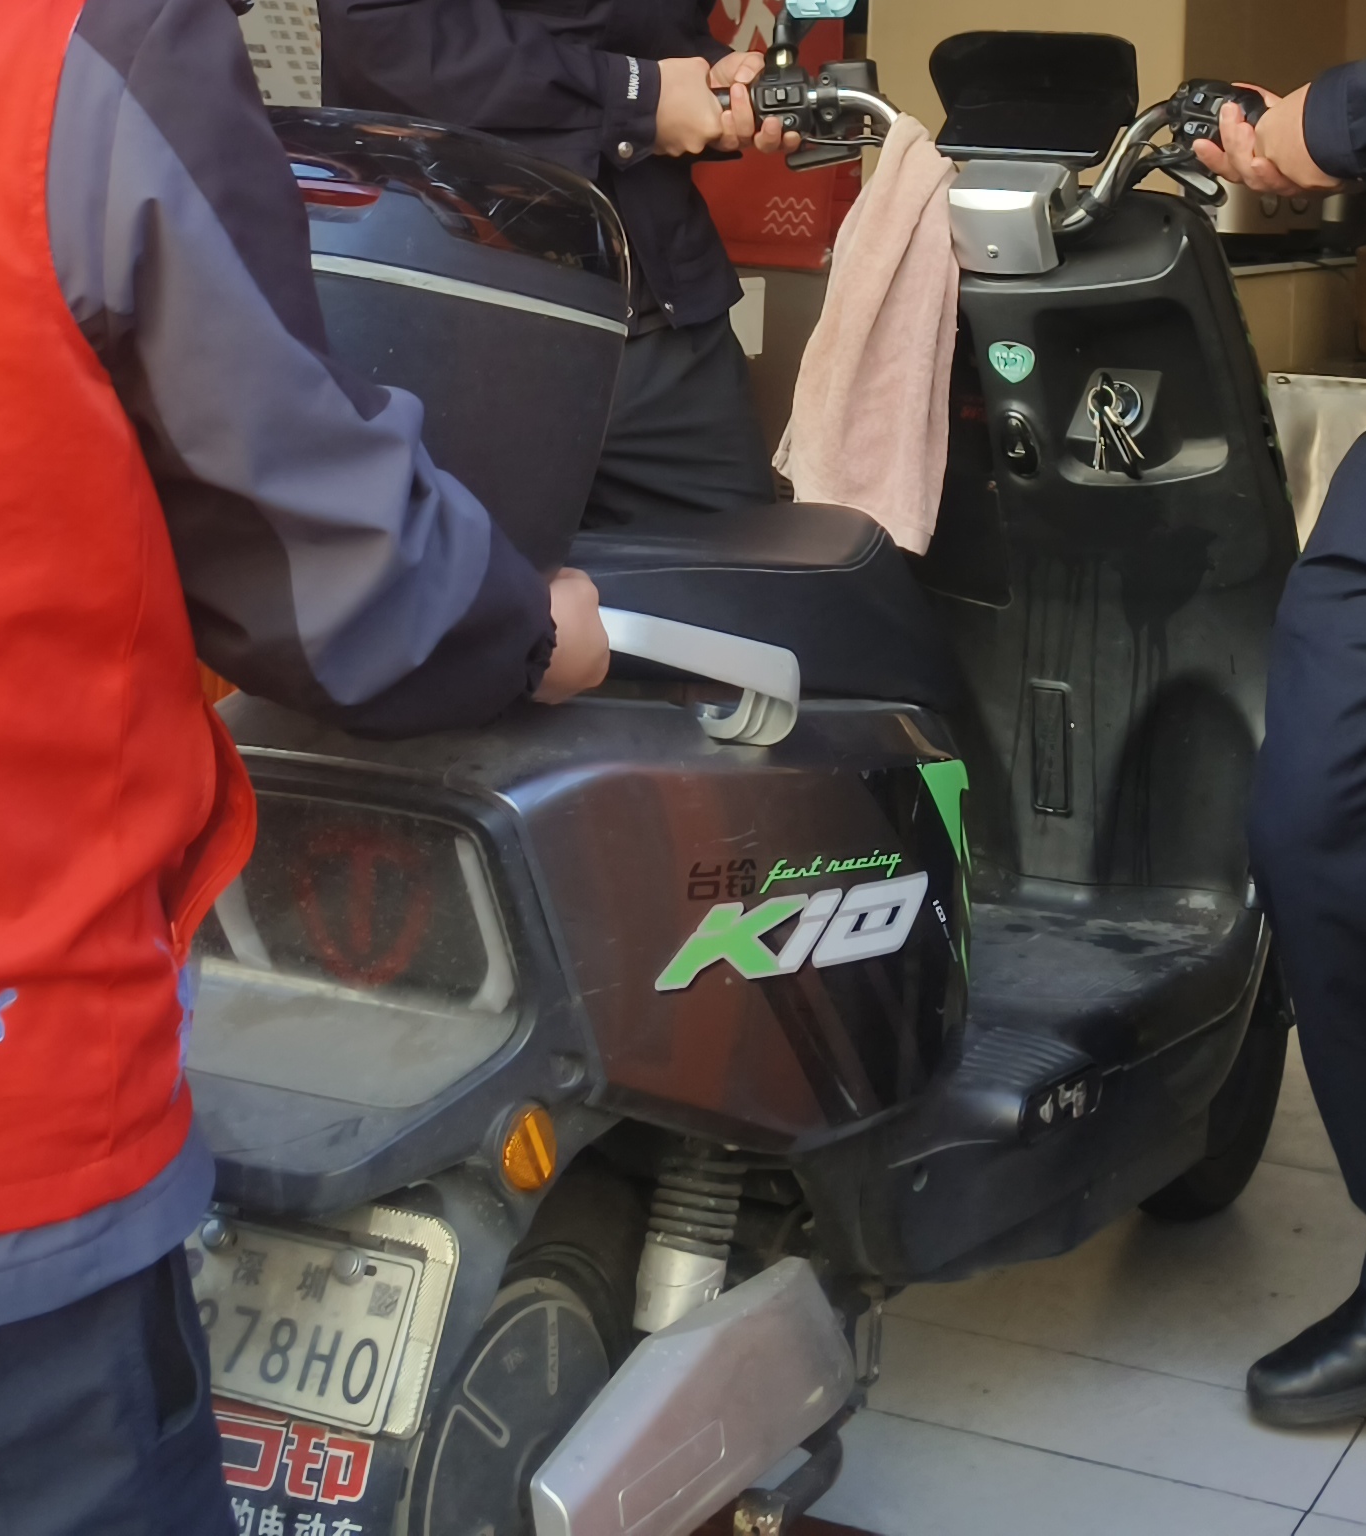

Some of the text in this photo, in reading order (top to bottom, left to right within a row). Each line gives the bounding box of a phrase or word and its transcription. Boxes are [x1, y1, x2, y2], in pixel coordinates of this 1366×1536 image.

[759, 849, 902, 894] fast racing
[655, 870, 929, 992] K10
[232, 1249, 331, 1304] 深圳
